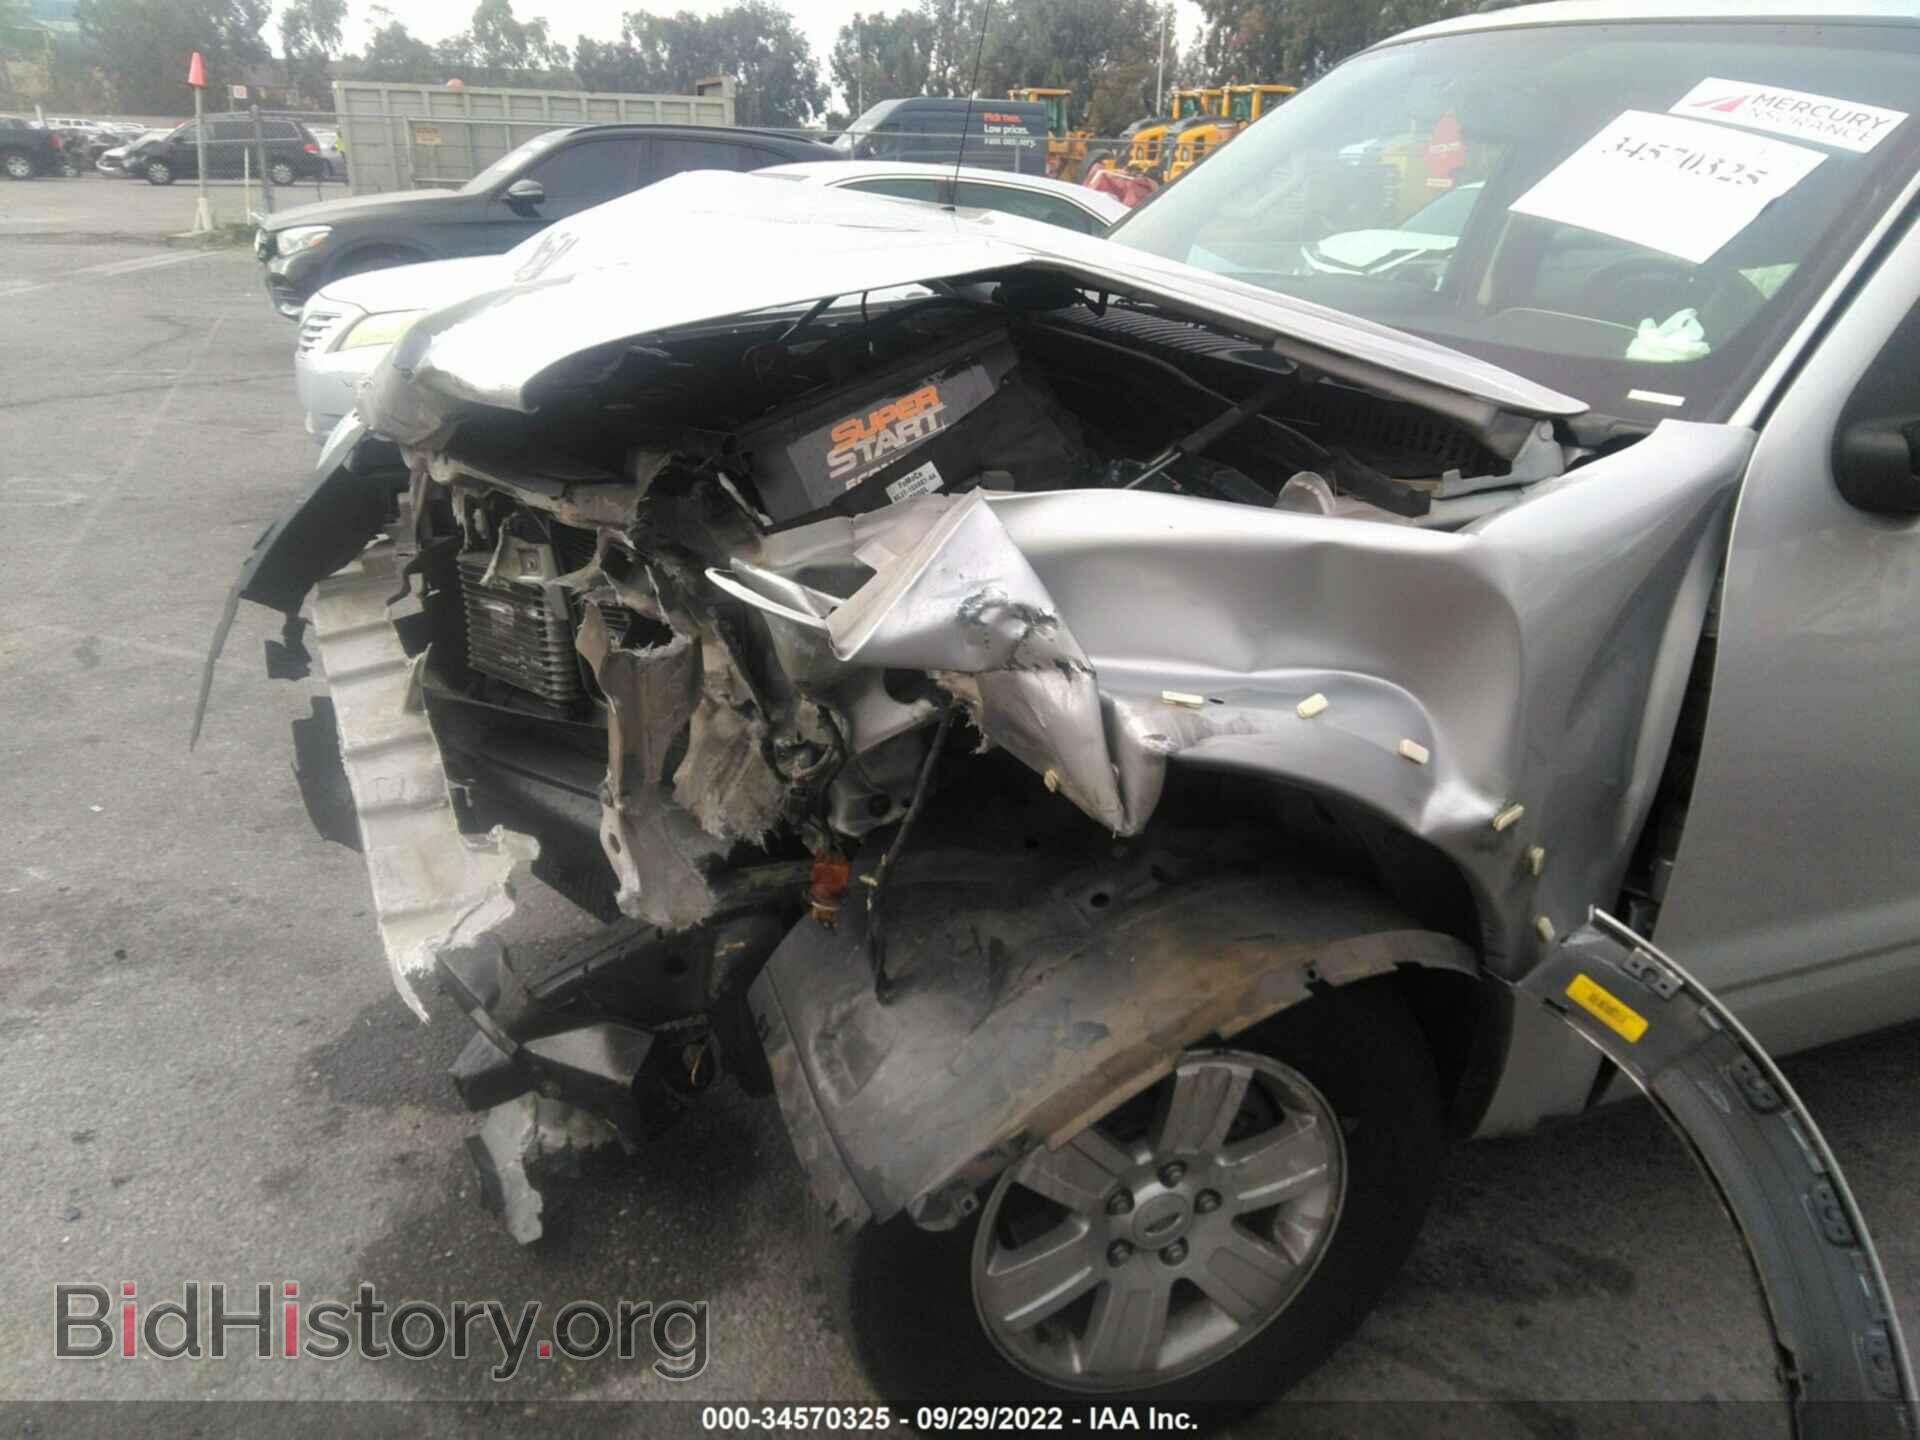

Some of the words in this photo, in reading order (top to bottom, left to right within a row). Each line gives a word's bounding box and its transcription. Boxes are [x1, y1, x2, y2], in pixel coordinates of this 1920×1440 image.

[984, 124, 1001, 133] Low
[1751, 92, 1891, 130] MERCURY
[1601, 135, 1769, 185] 34570325
[826, 401, 947, 479] START
[830, 384, 941, 453] SUPER
